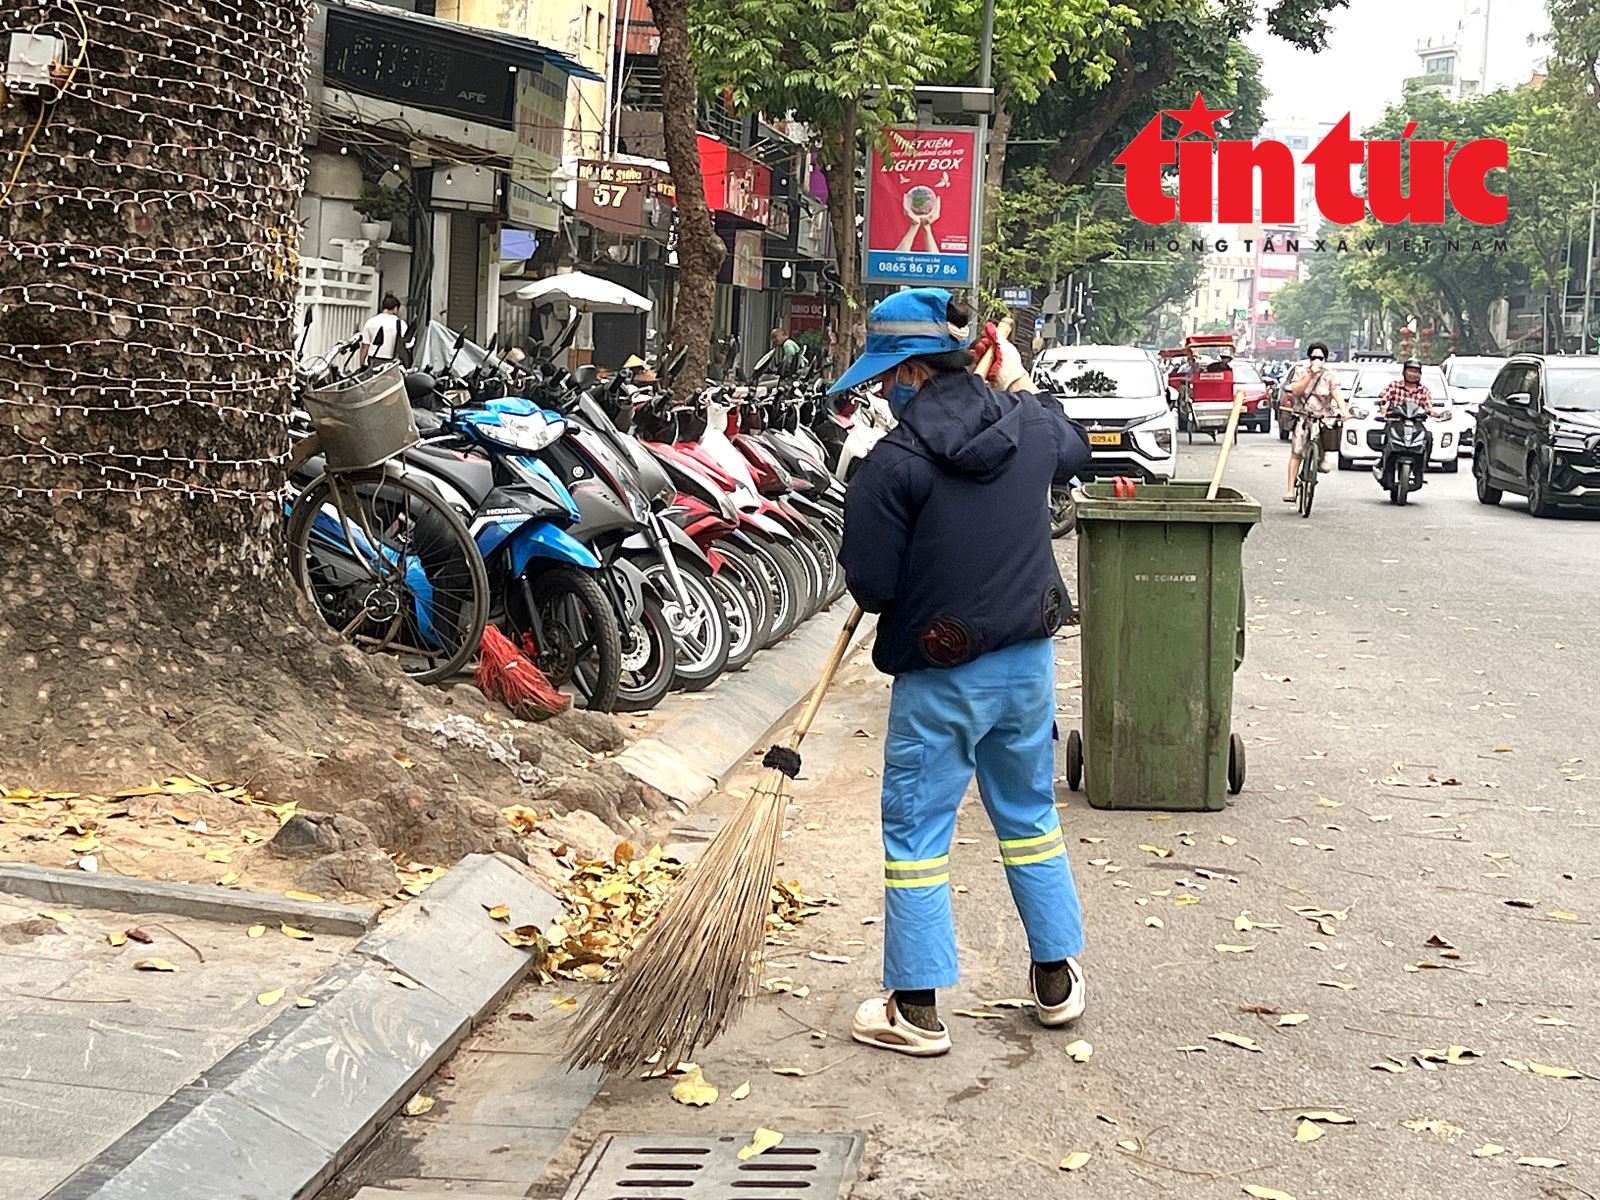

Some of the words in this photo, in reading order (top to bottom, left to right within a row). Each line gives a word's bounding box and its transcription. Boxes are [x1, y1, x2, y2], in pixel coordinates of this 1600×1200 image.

[924, 137, 953, 150] KIỆM
[927, 158, 963, 171] BOX
[593, 184, 628, 207] 57
[879, 262, 906, 272] 0865
[909, 263, 923, 273] 86
[926, 264, 940, 274] 87
[943, 265, 957, 275] 86
[486, 507, 522, 515] HONDA
